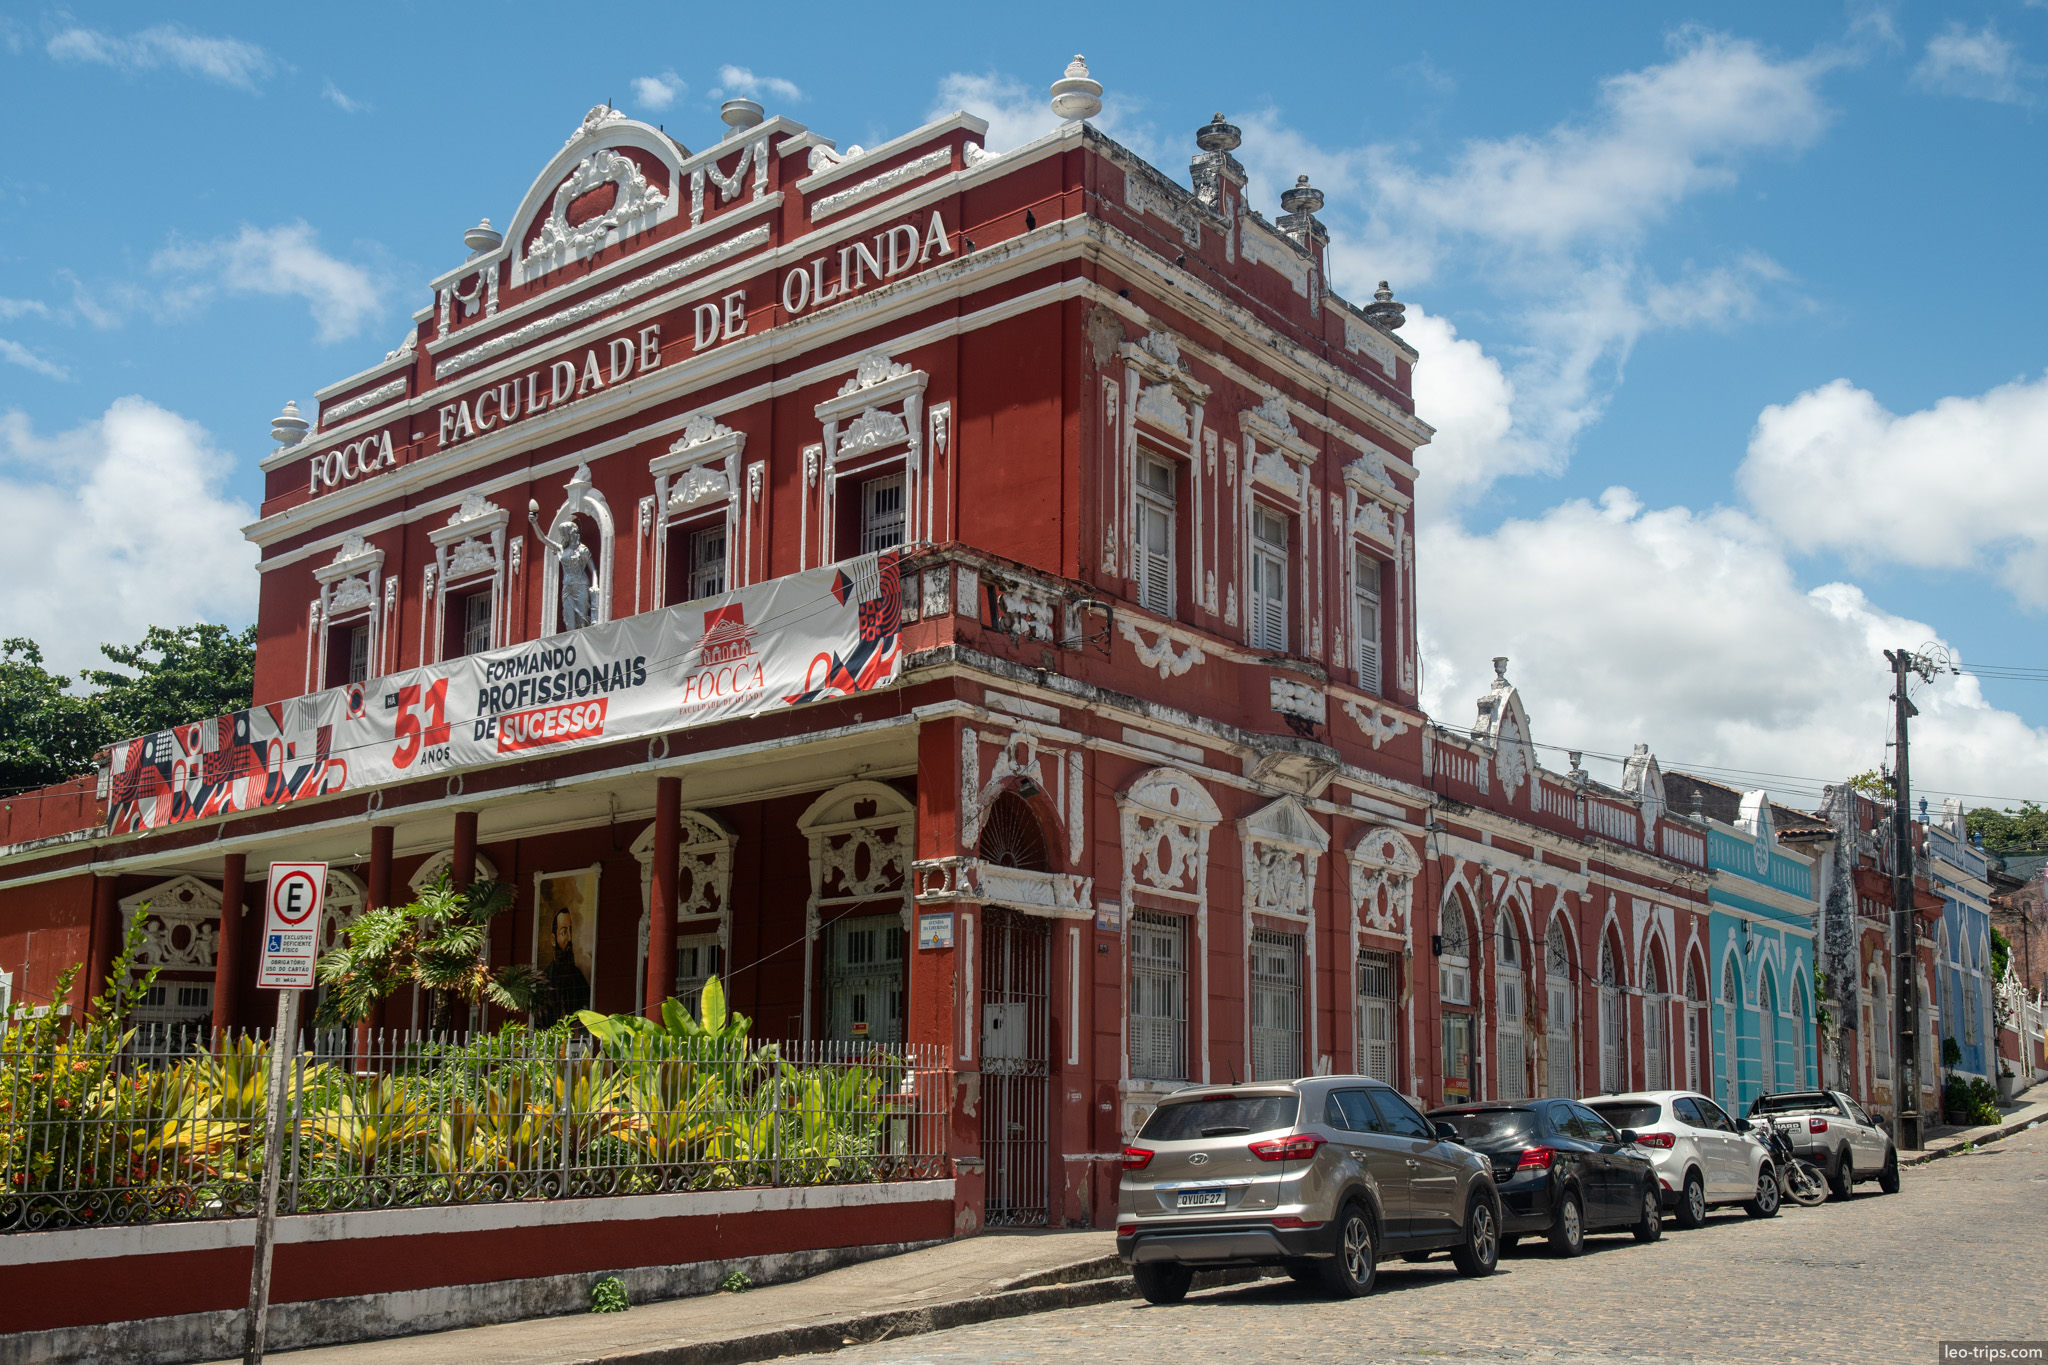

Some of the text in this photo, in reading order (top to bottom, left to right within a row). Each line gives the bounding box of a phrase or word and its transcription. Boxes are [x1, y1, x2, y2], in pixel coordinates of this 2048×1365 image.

[310, 210, 954, 493] FOCCA - FACULDADE DE OLINDA
[486, 645, 577, 683] FORMANDO
[681, 660, 765, 704] FOCCA
[387, 695, 396, 706] HÁ
[478, 655, 647, 716] PROFISSIONAIS
[679, 691, 764, 715] FACULDADE DE OLINDA
[392, 677, 451, 769] 51
[473, 702, 605, 745] DE SUCESSO.
[420, 746, 450, 765] ANOS
[286, 883, 304, 912] E
